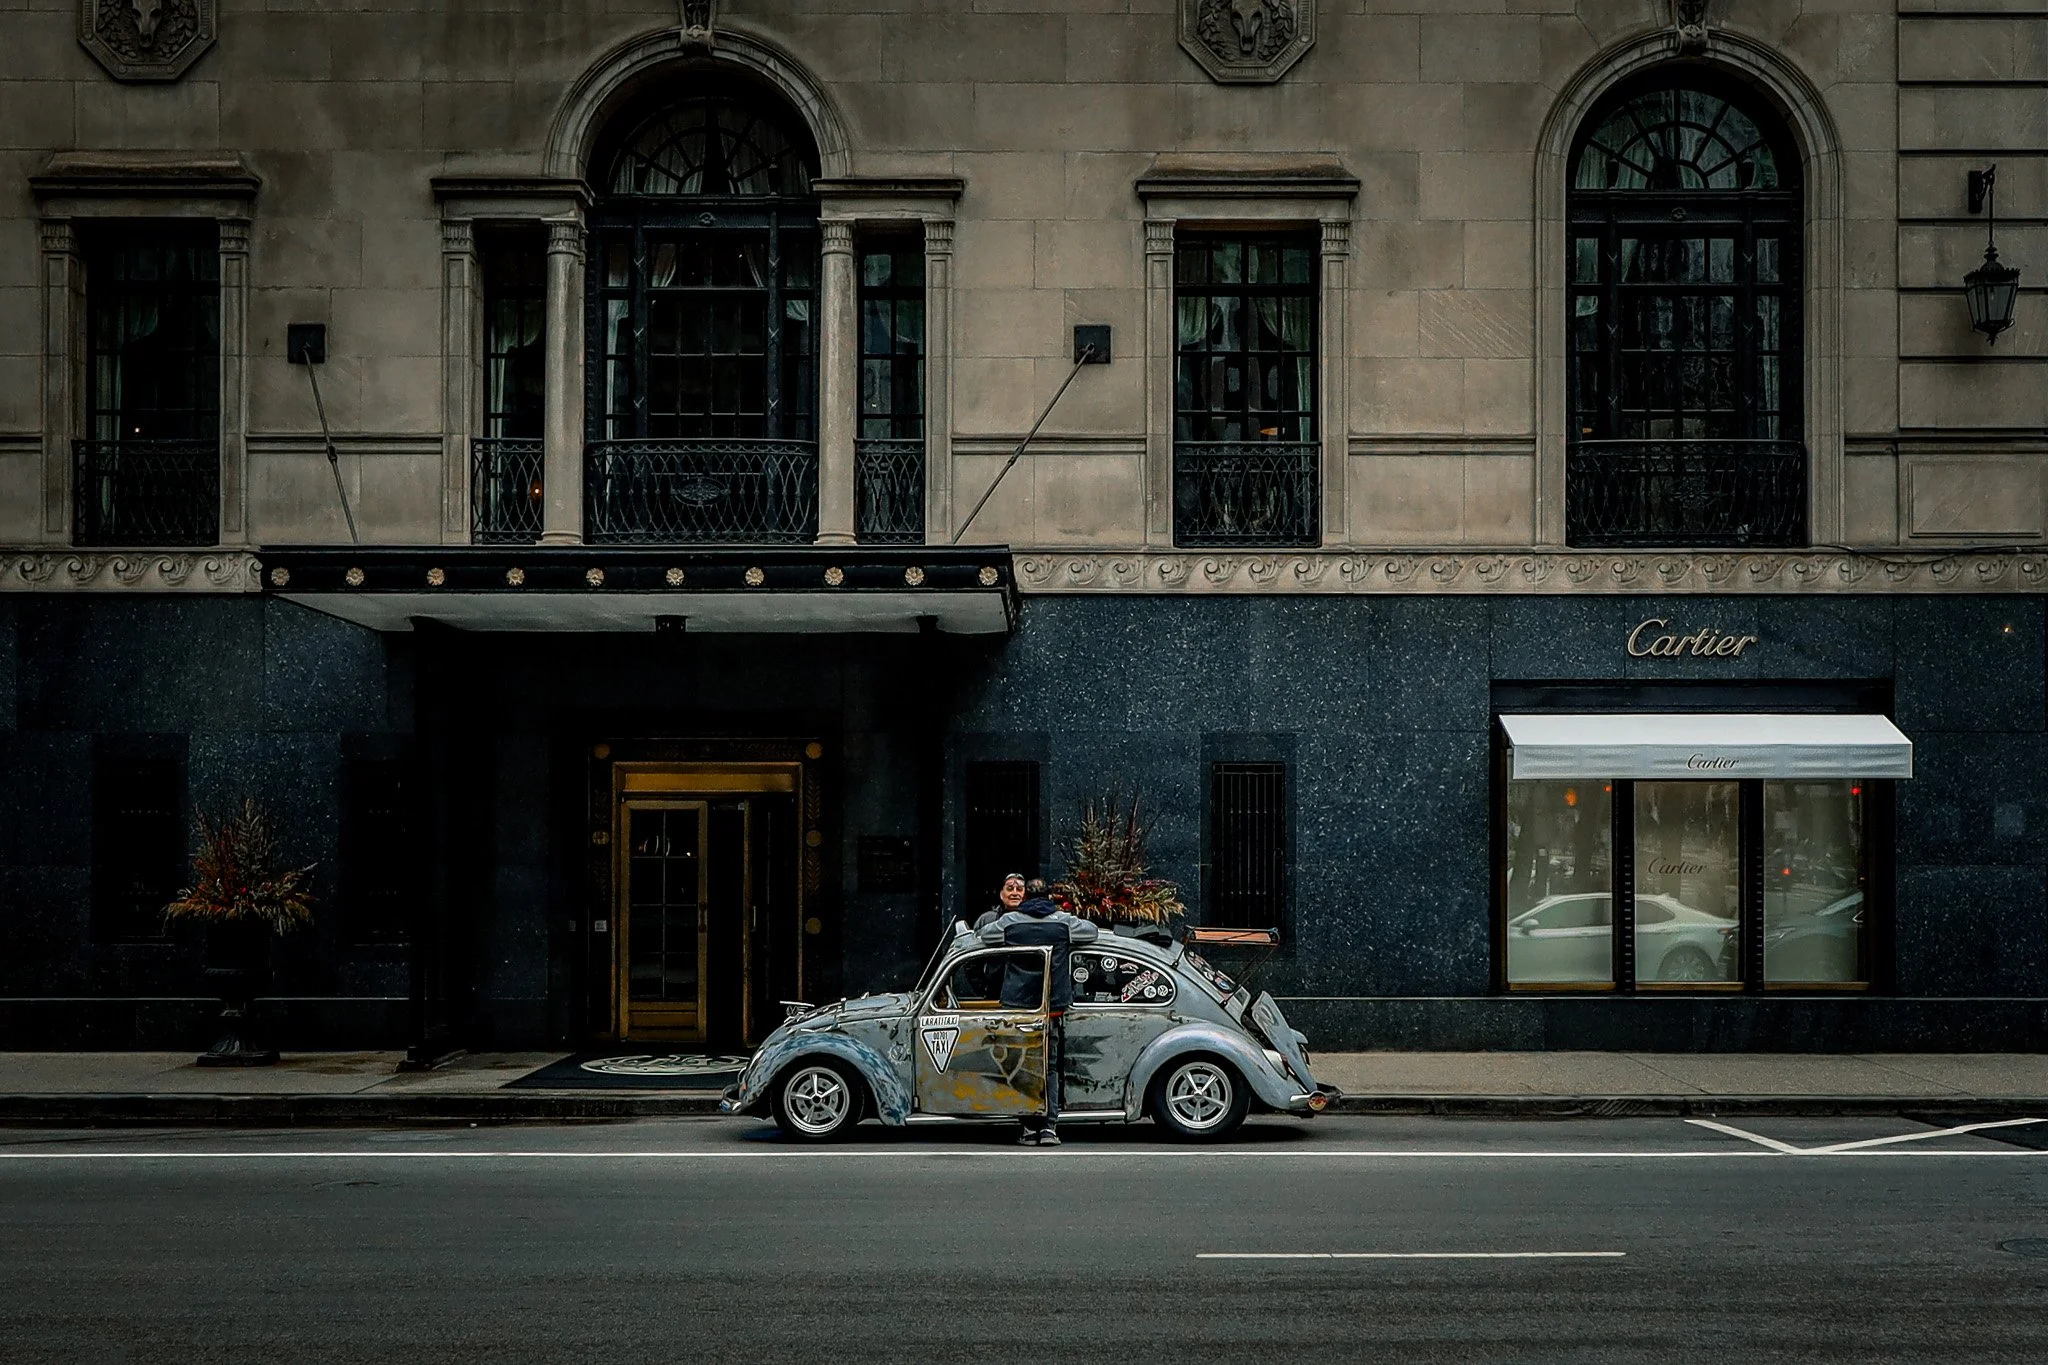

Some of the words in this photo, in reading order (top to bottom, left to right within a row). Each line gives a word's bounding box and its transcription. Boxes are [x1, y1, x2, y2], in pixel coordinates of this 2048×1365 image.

[1627, 618, 1758, 657] Cartier
[1687, 753, 1740, 769] Cartier
[1648, 857, 1708, 874] Cartier
[931, 1040, 949, 1054] TAXI
